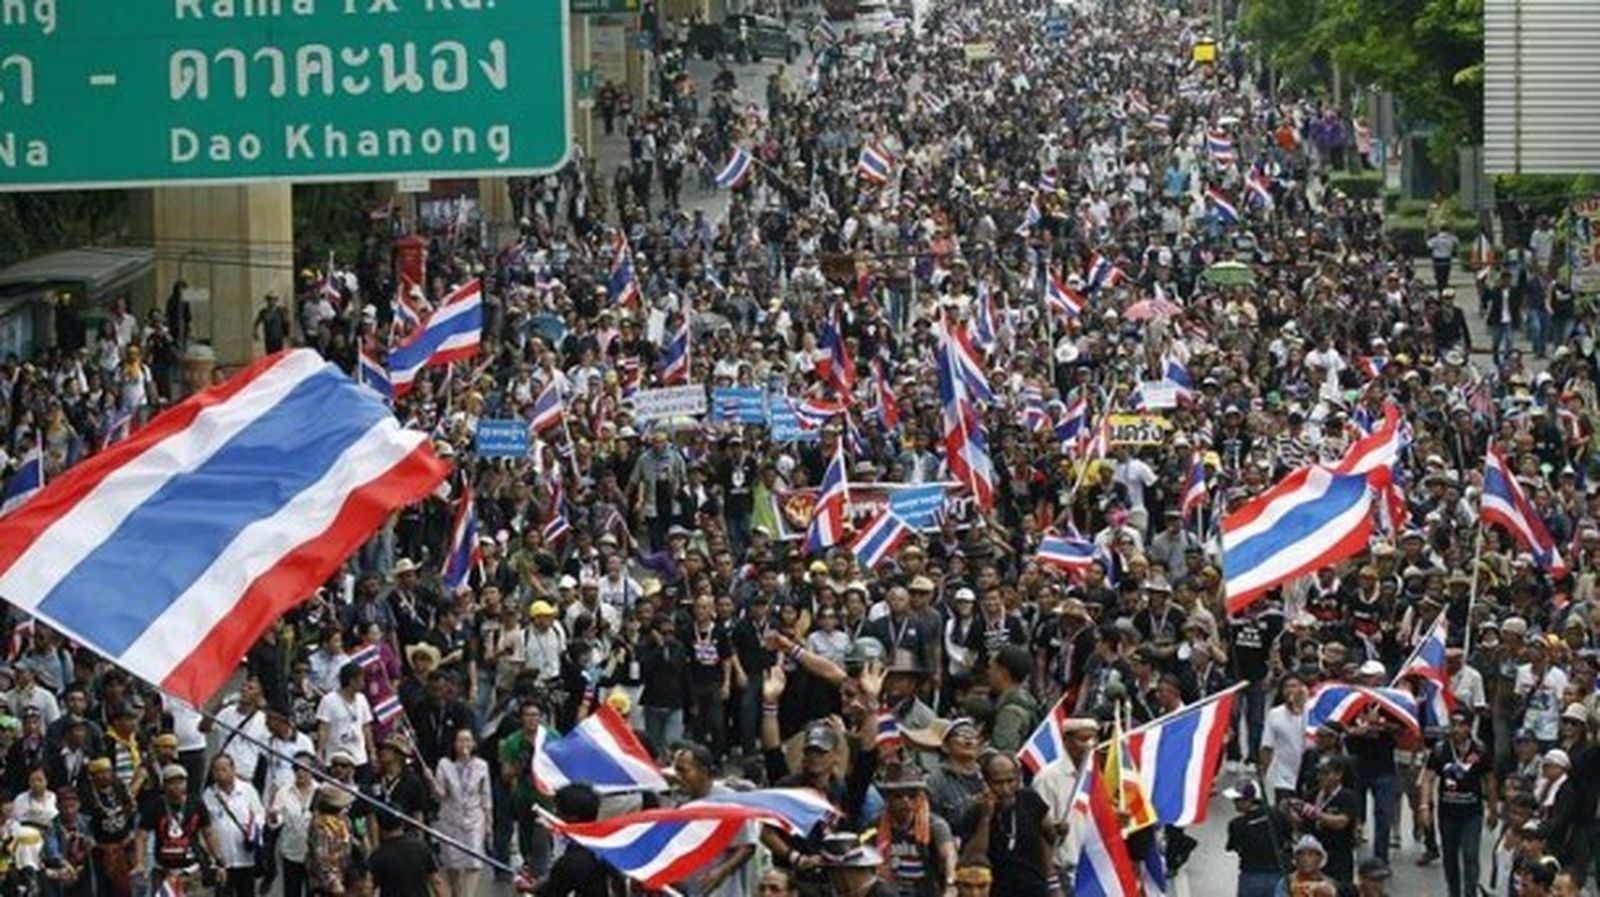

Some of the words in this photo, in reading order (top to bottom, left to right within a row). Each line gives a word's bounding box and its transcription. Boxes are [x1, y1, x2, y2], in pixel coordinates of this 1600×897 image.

[0, 53, 33, 105] า
[169, 38, 509, 101] ดาวคะนอง
[170, 126, 261, 163] Dao
[285, 123, 510, 163] Khanong
